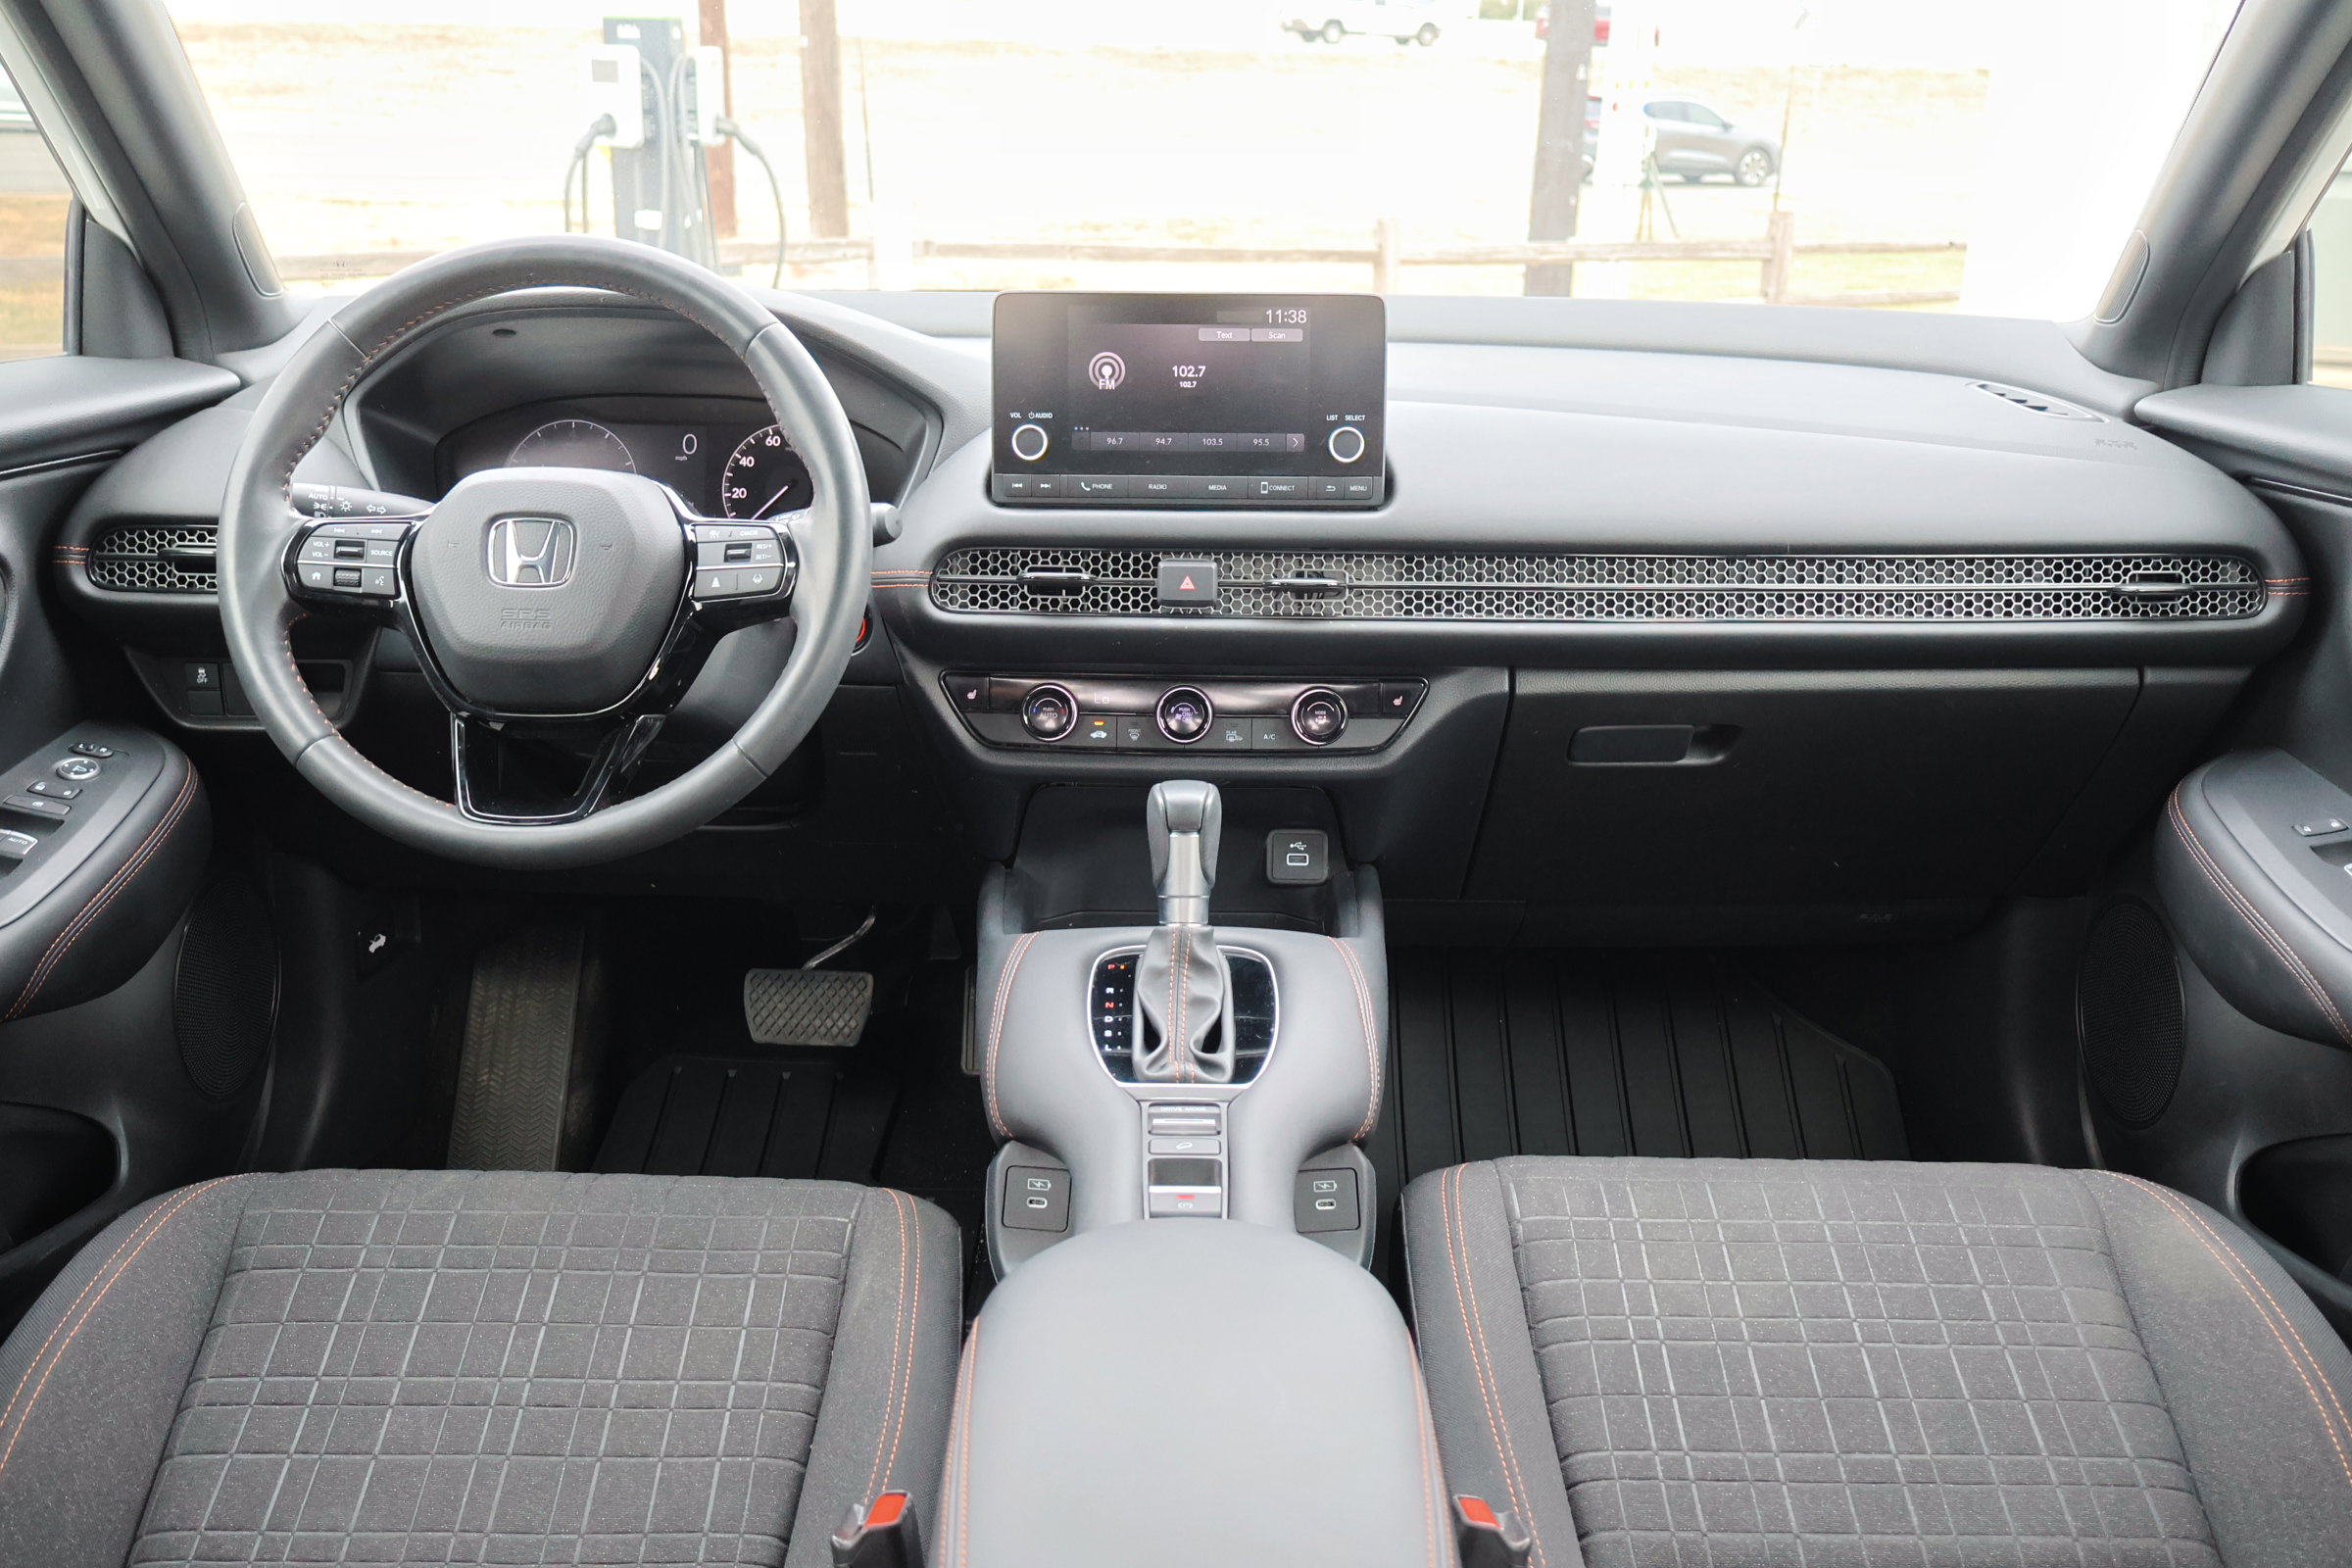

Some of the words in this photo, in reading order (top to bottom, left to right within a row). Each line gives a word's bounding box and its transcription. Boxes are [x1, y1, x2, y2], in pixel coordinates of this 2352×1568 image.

[1266, 309, 1307, 323] 11:38
[1216, 330, 1233, 339] Text
[1172, 366, 1206, 377] 102.7
[1099, 378, 1115, 390] FM
[682, 433, 697, 455] 0
[765, 435, 781, 447] 60
[739, 456, 755, 467] 40
[731, 487, 747, 499] 20
[8, 837, 28, 846] AUTO
